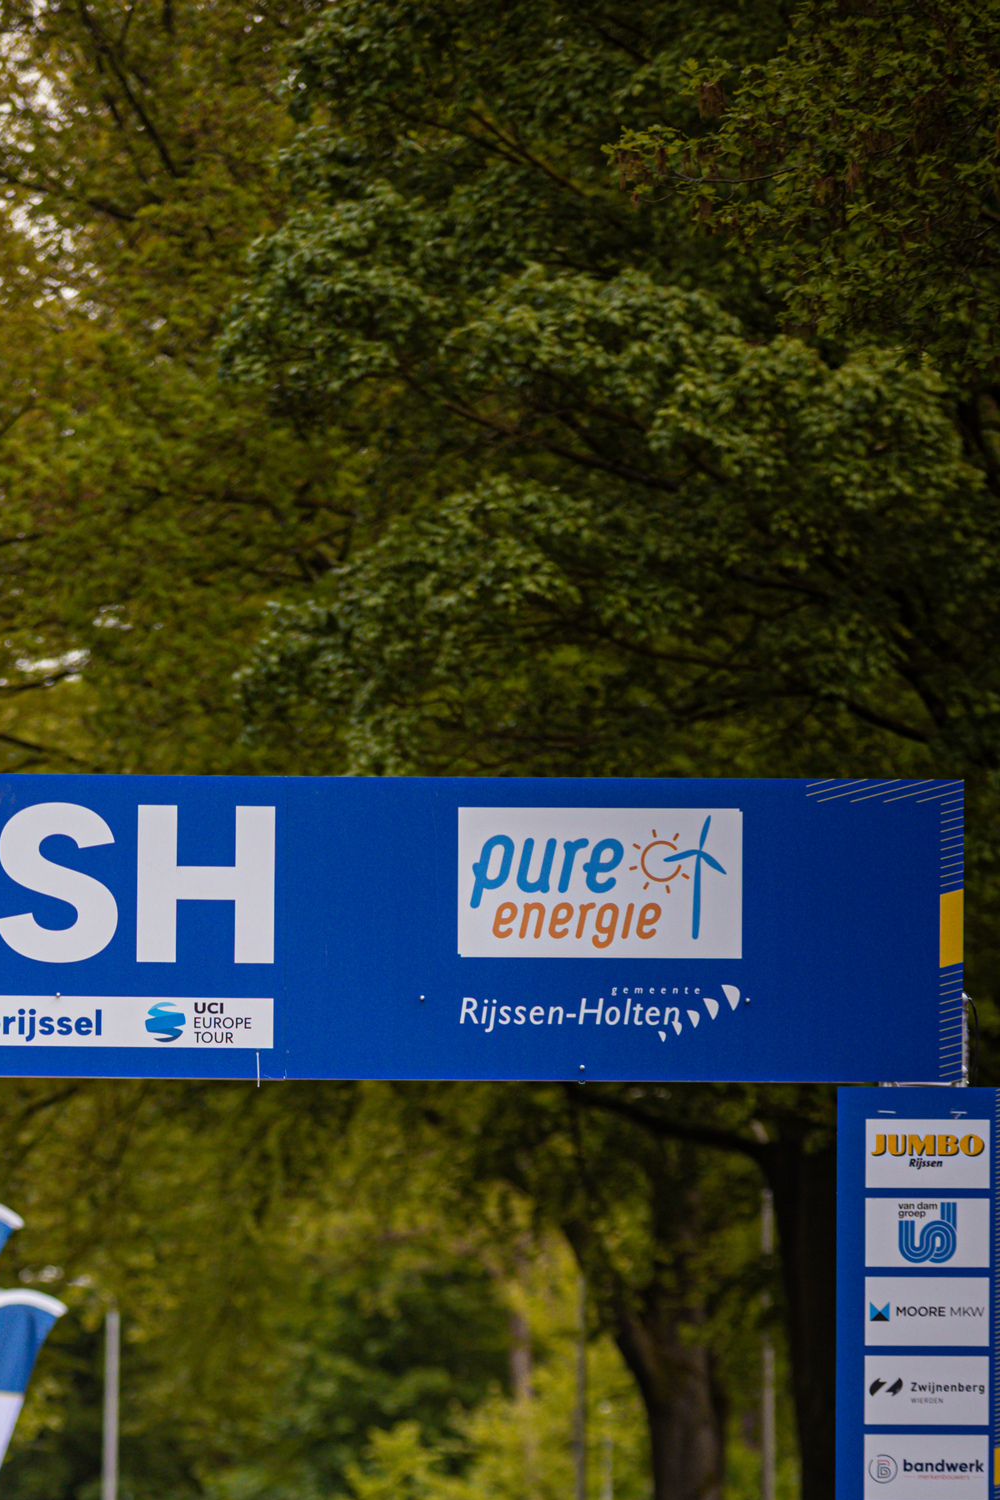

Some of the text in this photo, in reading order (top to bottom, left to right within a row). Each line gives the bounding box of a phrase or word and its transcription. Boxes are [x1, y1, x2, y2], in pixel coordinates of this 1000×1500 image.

[470, 834, 624, 909] pure
[492, 901, 662, 949] energie
[611, 985, 702, 996] gemeente
[193, 1001, 225, 1014] UCI
[459, 996, 682, 1033] Rijssen-Holten
[193, 1015, 252, 1031] EUROPE
[193, 1030, 234, 1044] TOUR
[870, 1133, 985, 1157] JUMBO
[908, 1157, 944, 1171] Rijssen
[898, 1201, 938, 1211] van dam
[898, 1210, 927, 1219] groep
[896, 1306, 986, 1317] MOORE MKW
[910, 1381, 986, 1395] Zwijnenberg
[903, 1458, 985, 1473] bandwerk
